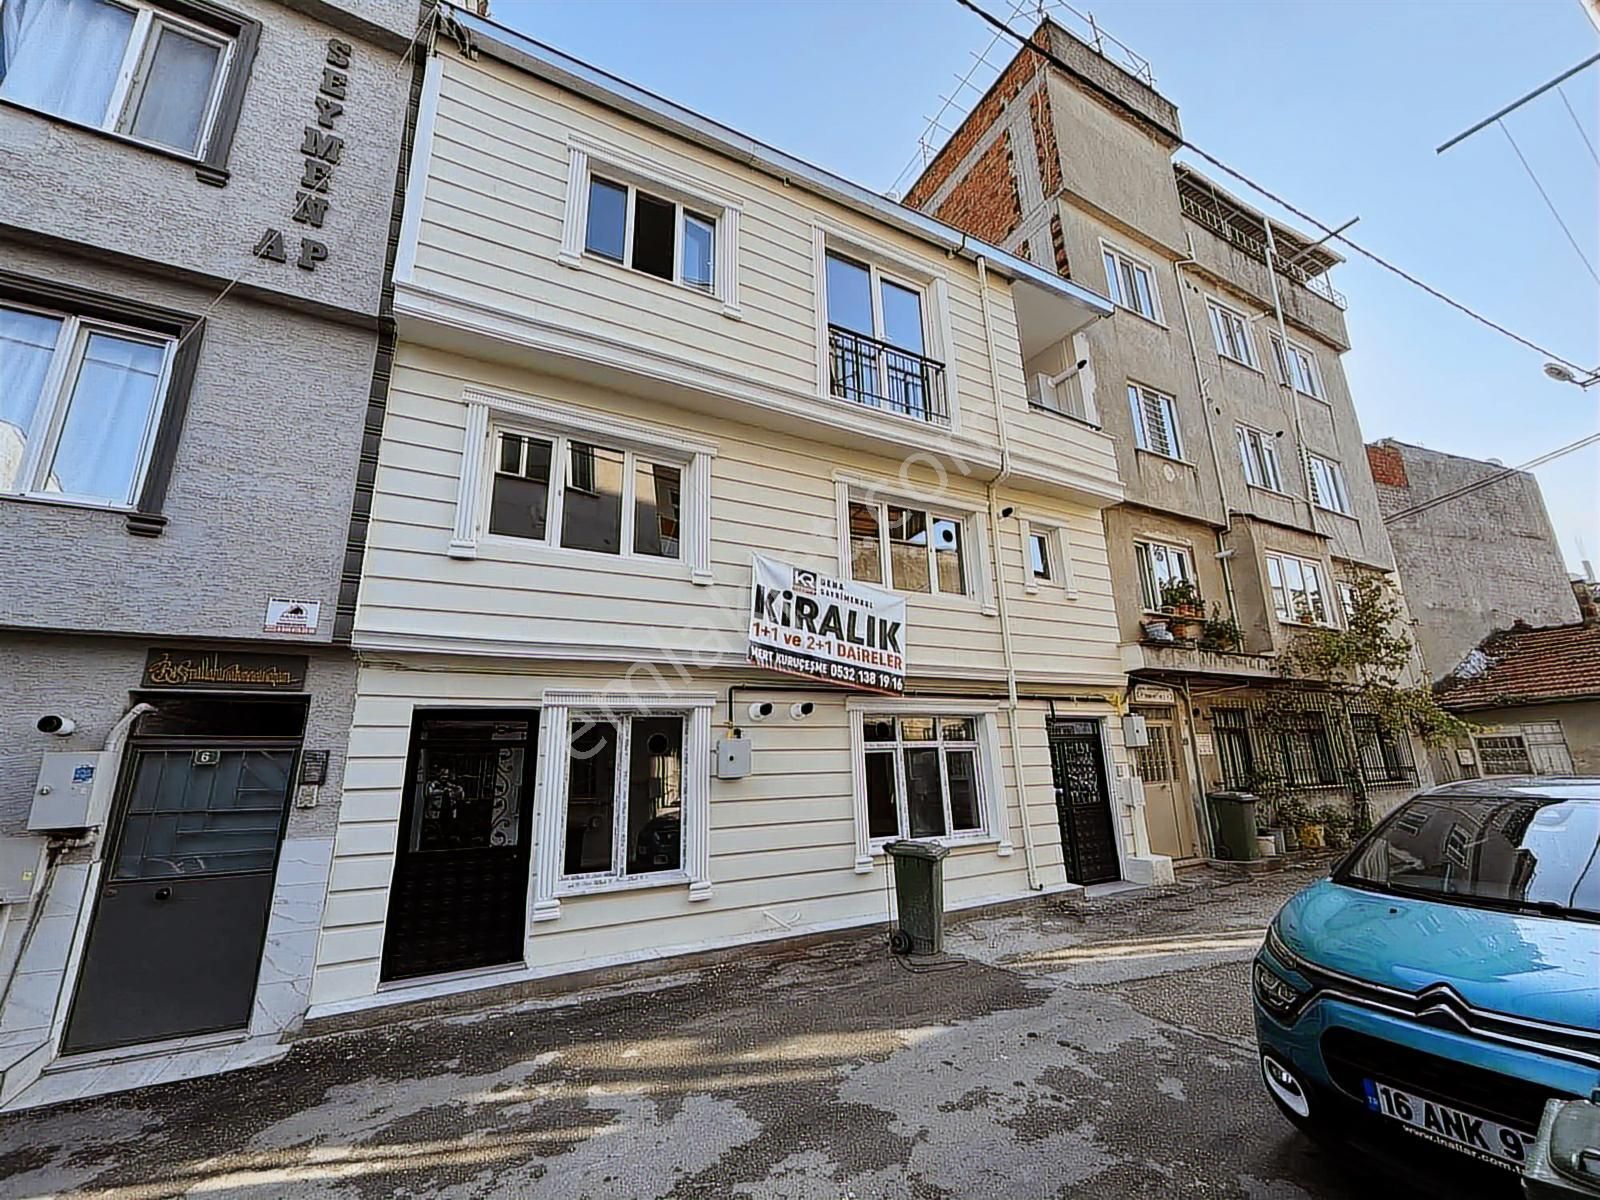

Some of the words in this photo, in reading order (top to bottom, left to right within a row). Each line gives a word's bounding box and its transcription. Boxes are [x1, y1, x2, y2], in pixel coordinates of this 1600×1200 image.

[292, 37, 352, 228] SEYMEN
[253, 228, 329, 271] AP
[753, 622, 778, 641] 1+1
[784, 633, 802, 646] ve
[807, 636, 832, 655] 2+1
[830, 663, 855, 681] 0532
[858, 670, 876, 685] 138
[880, 674, 890, 688] 19
[892, 677, 903, 691] 16
[201, 752, 210, 762] 6
[1380, 1086, 1413, 1121] 16
[1424, 1101, 1492, 1151] ANK
[1499, 1128, 1536, 1162] 9
